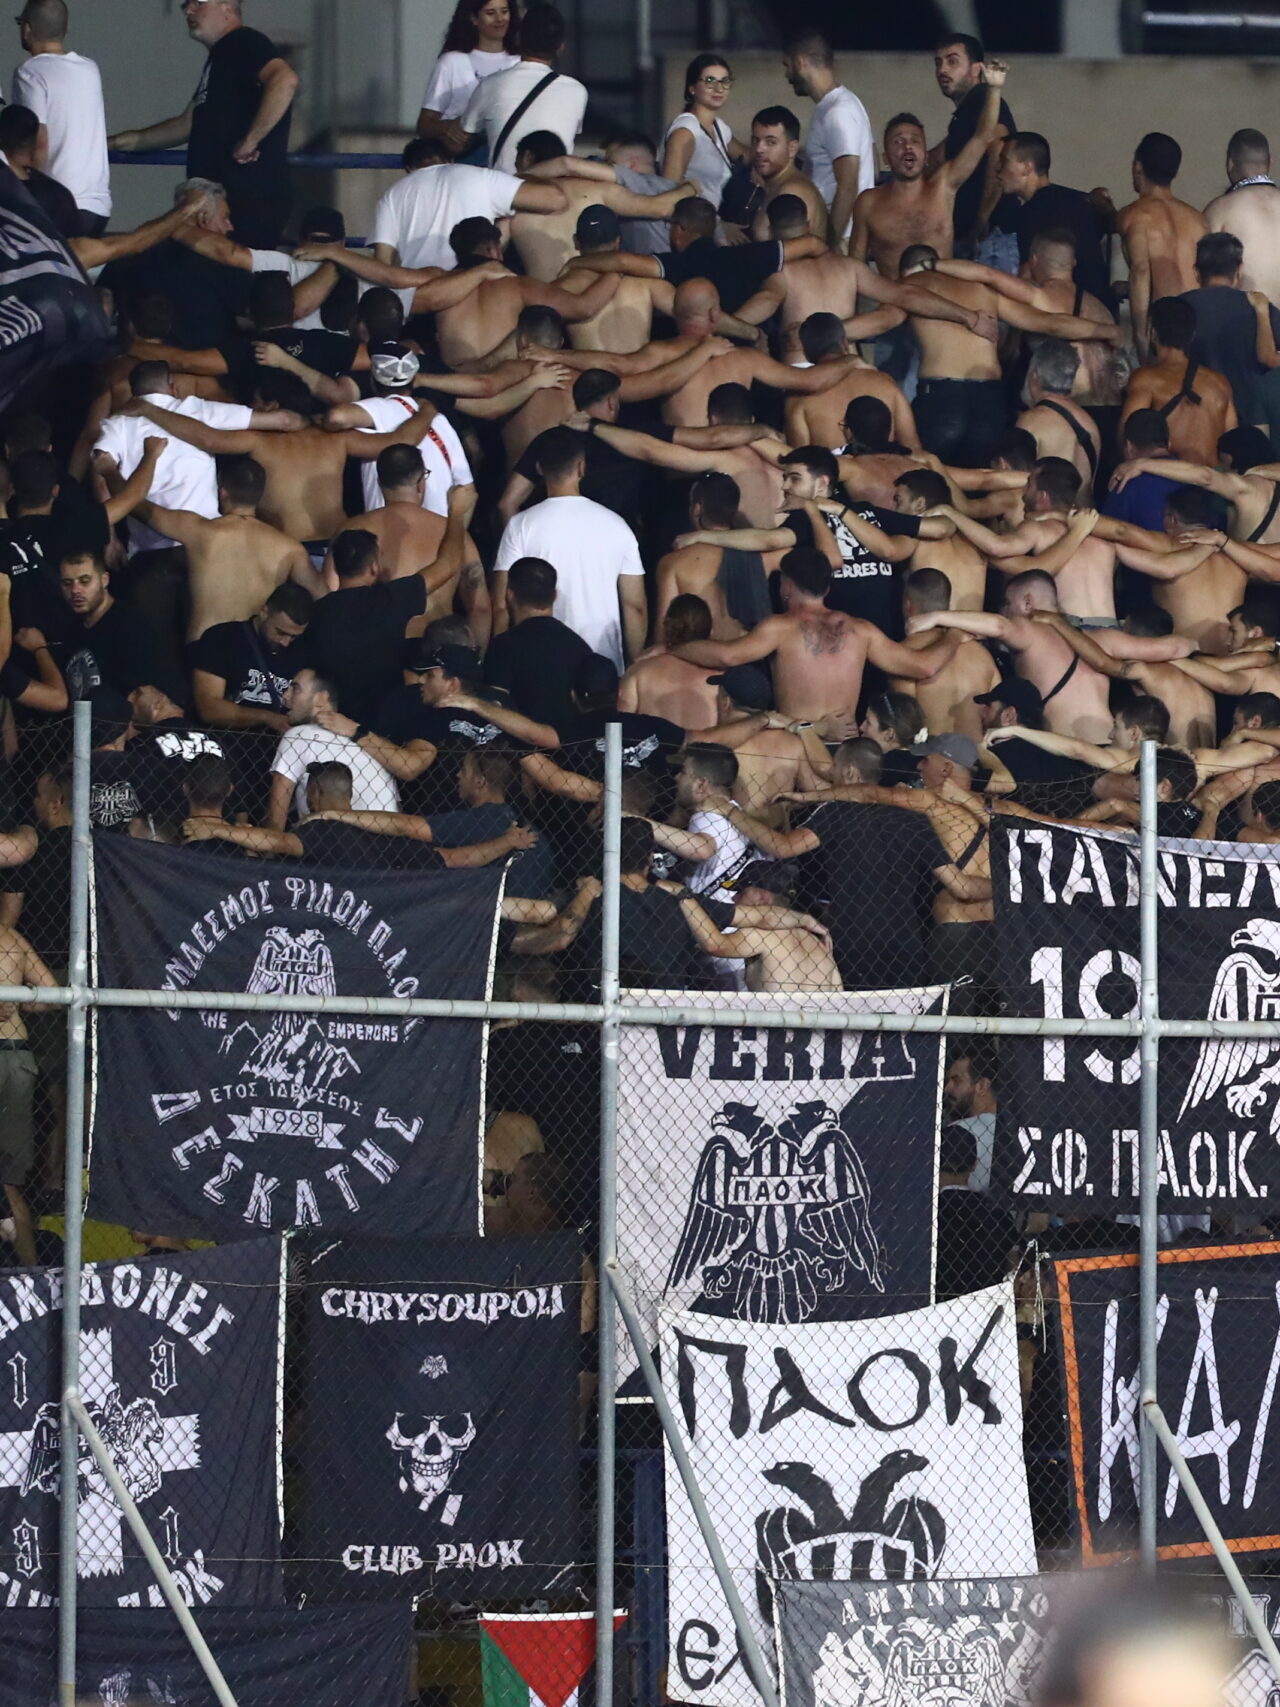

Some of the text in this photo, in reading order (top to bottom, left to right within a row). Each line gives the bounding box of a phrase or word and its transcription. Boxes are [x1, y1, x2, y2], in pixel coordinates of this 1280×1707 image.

[285, 877, 373, 935] ΦΙΛΩΝ
[328, 1022, 399, 1042] EMPERORS
[656, 1014, 916, 1081] VERIA
[210, 1082, 258, 1103] ΕΤΟΣ
[260, 1109, 319, 1136] 1998
[734, 1176, 823, 1202] ΠΑΟΚ
[321, 1285, 566, 1327] CHRYSOUPOLI
[672, 1304, 1003, 1440] ΠΑΟΚ
[341, 1540, 525, 1575] CLUB PAOK
[914, 1659, 977, 1674] ΠΑΟΚ
